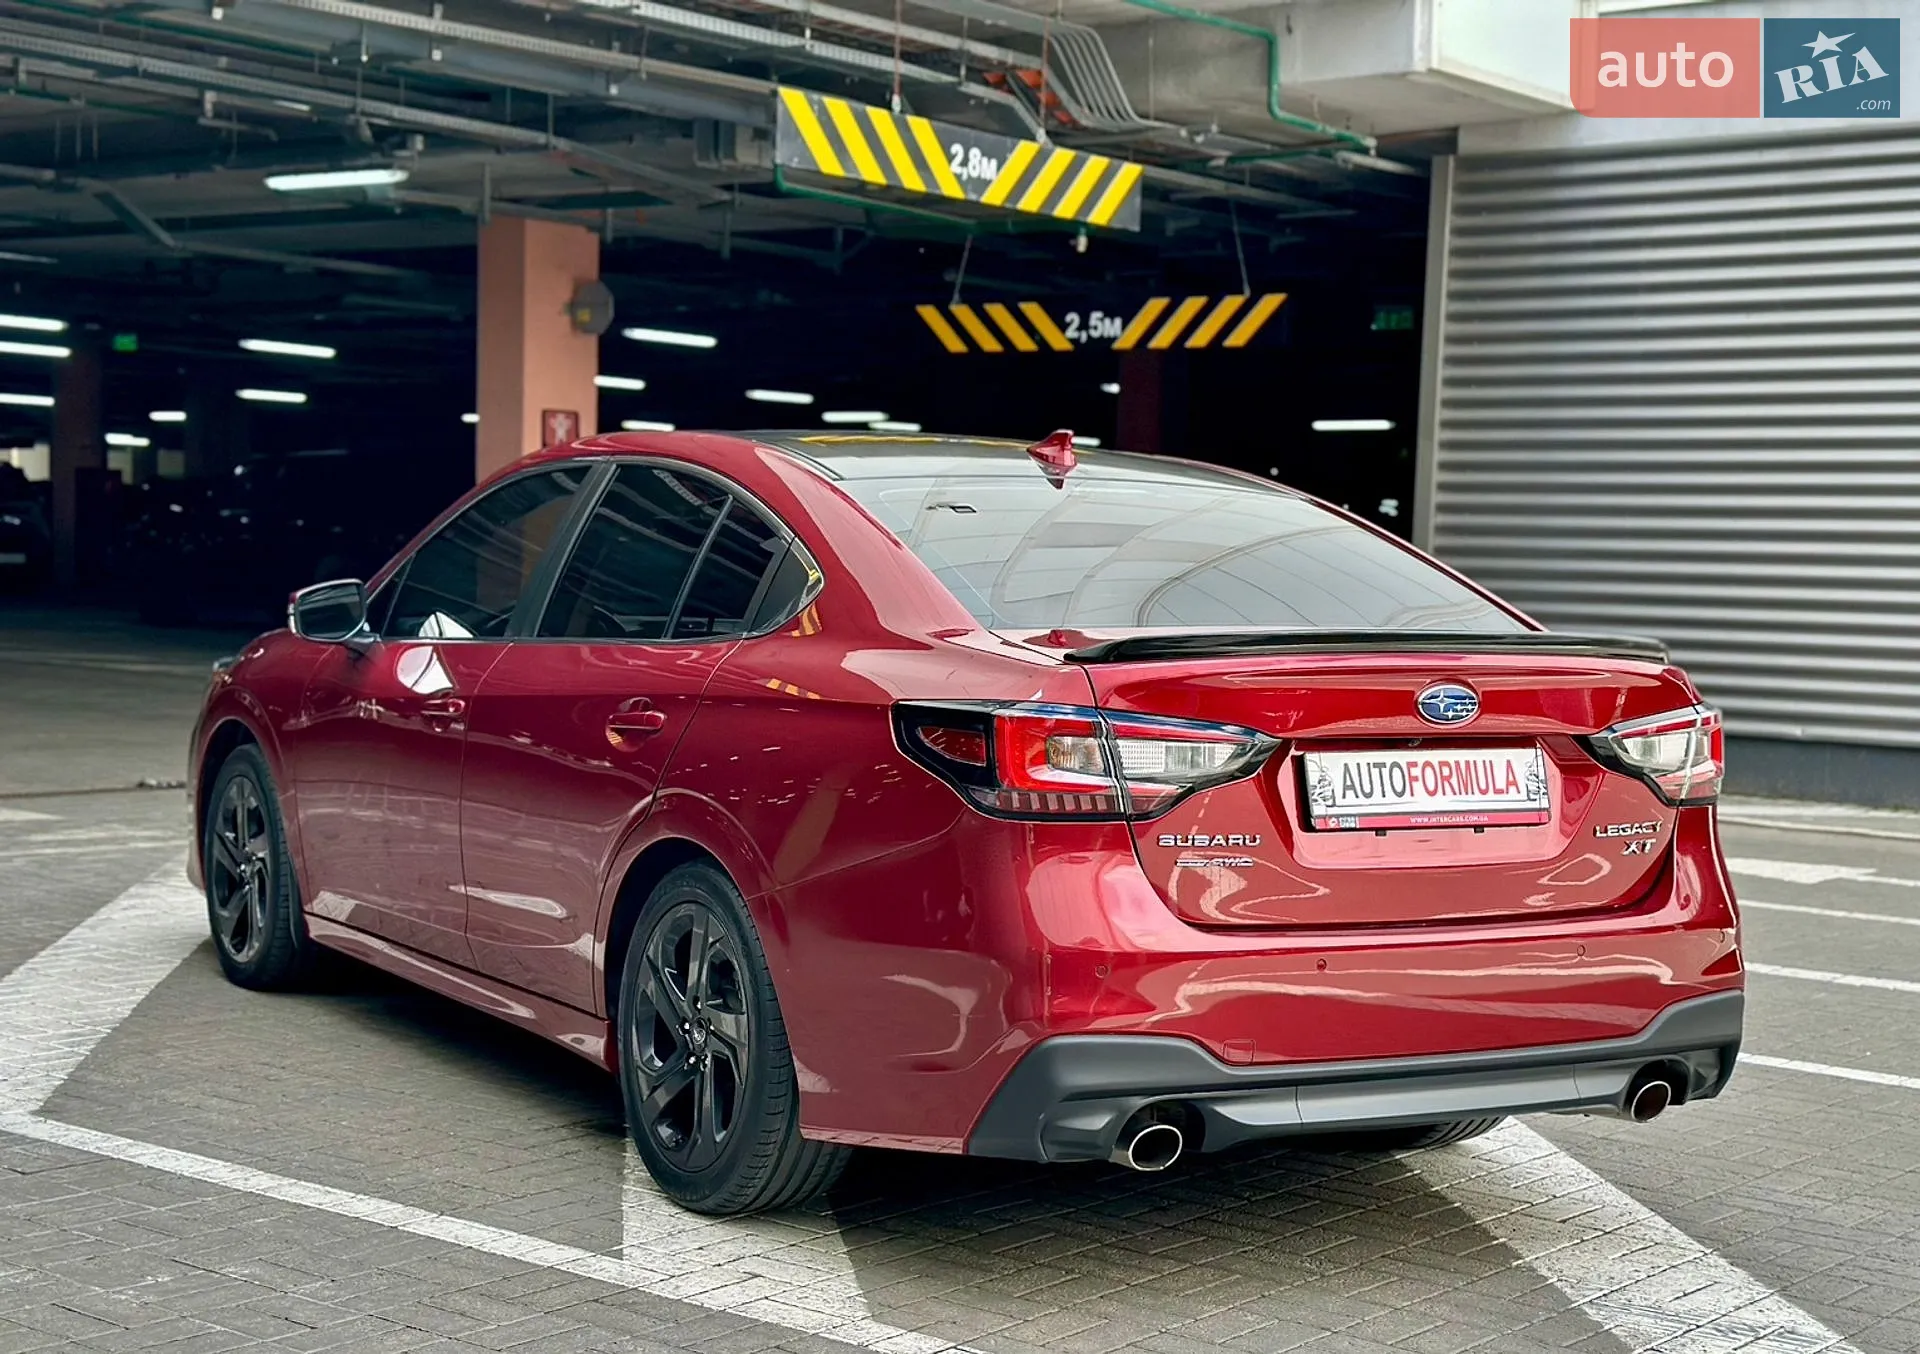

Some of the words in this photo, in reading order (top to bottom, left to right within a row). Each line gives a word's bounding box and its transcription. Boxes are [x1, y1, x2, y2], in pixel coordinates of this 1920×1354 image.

[1341, 759, 1521, 800] AUTOFORMULA
[1594, 820, 1663, 838] LEGACY
[1158, 834, 1261, 847] SUBARU
[1620, 838, 1657, 855] XT
